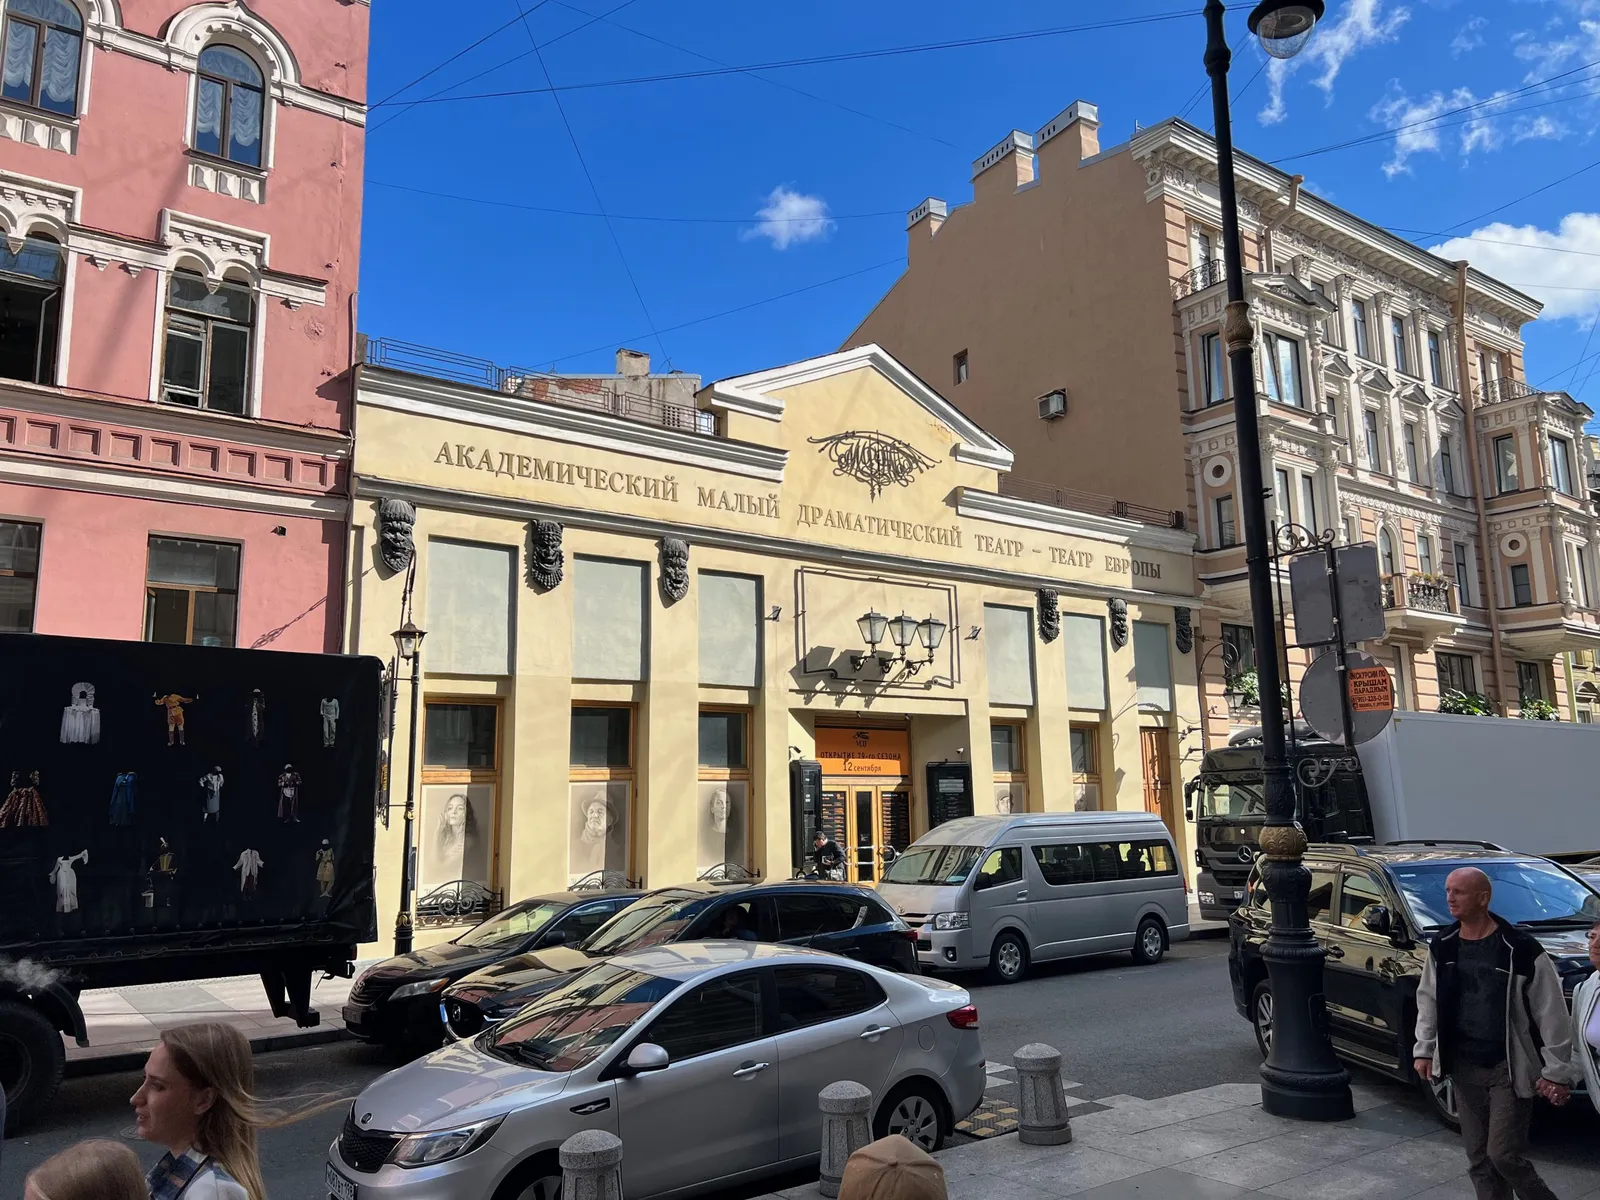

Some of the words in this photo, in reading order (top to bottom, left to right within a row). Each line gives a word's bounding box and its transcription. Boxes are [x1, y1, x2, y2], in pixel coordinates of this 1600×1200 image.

[434, 441, 679, 502] АКАДЕМИЧЕСКИЙ
[697, 486, 780, 519] МАЛЫЙ
[797, 503, 962, 548] ДРАМАТИЧЕСКИЙ
[974, 533, 1024, 558] ТЕАТР
[1049, 547, 1094, 568] ТЕАТР
[1104, 555, 1161, 580] ЕВРОПЫ
[1378, 670, 1385, 678] ПО
[1354, 679, 1387, 687] КРЫШАМ
[1354, 686, 1387, 694] ПАРАДНЫМ
[877, 752, 901, 760] СЕЗОНА
[843, 761, 853, 771] 12
[854, 764, 881, 773] сентября
